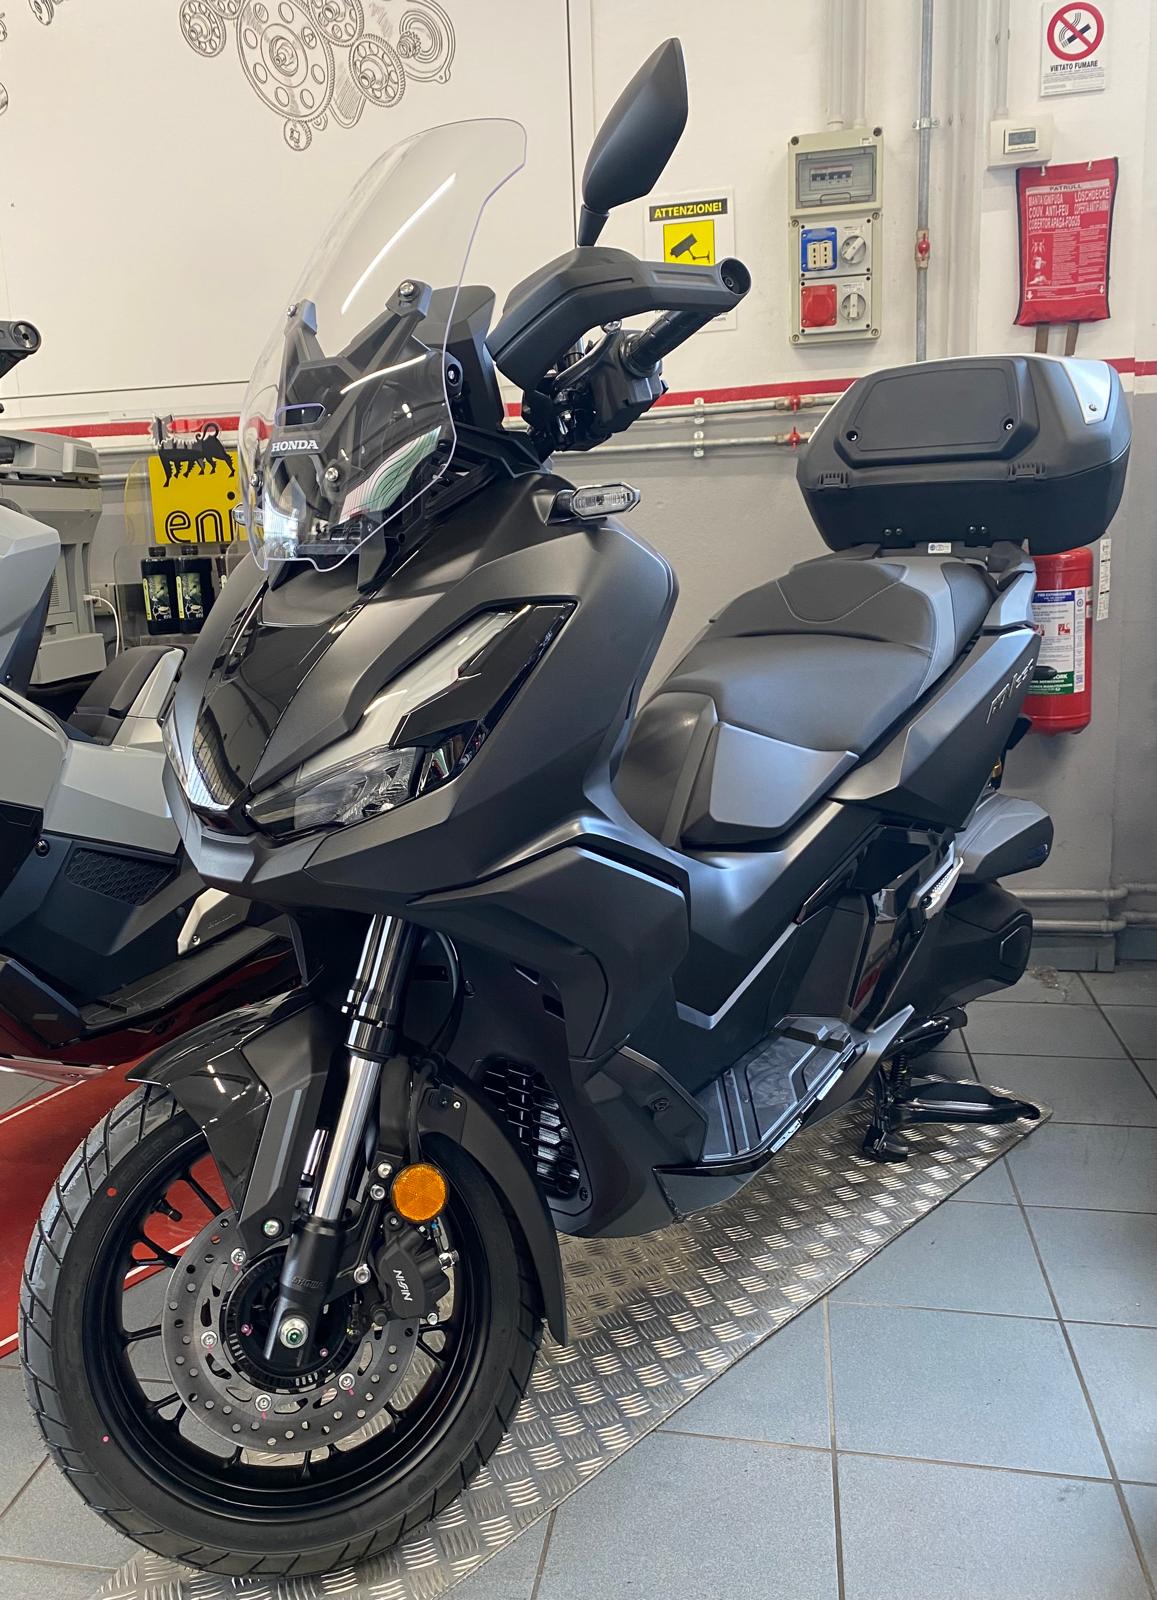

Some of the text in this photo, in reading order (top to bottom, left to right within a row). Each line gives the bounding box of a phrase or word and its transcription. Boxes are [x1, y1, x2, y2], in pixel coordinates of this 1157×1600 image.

[1050, 60, 1098, 72] VIETATO FUMARE
[654, 202, 722, 219] ATTENZIONE!
[271, 440, 319, 452] HONDA
[165, 491, 238, 543] eni
